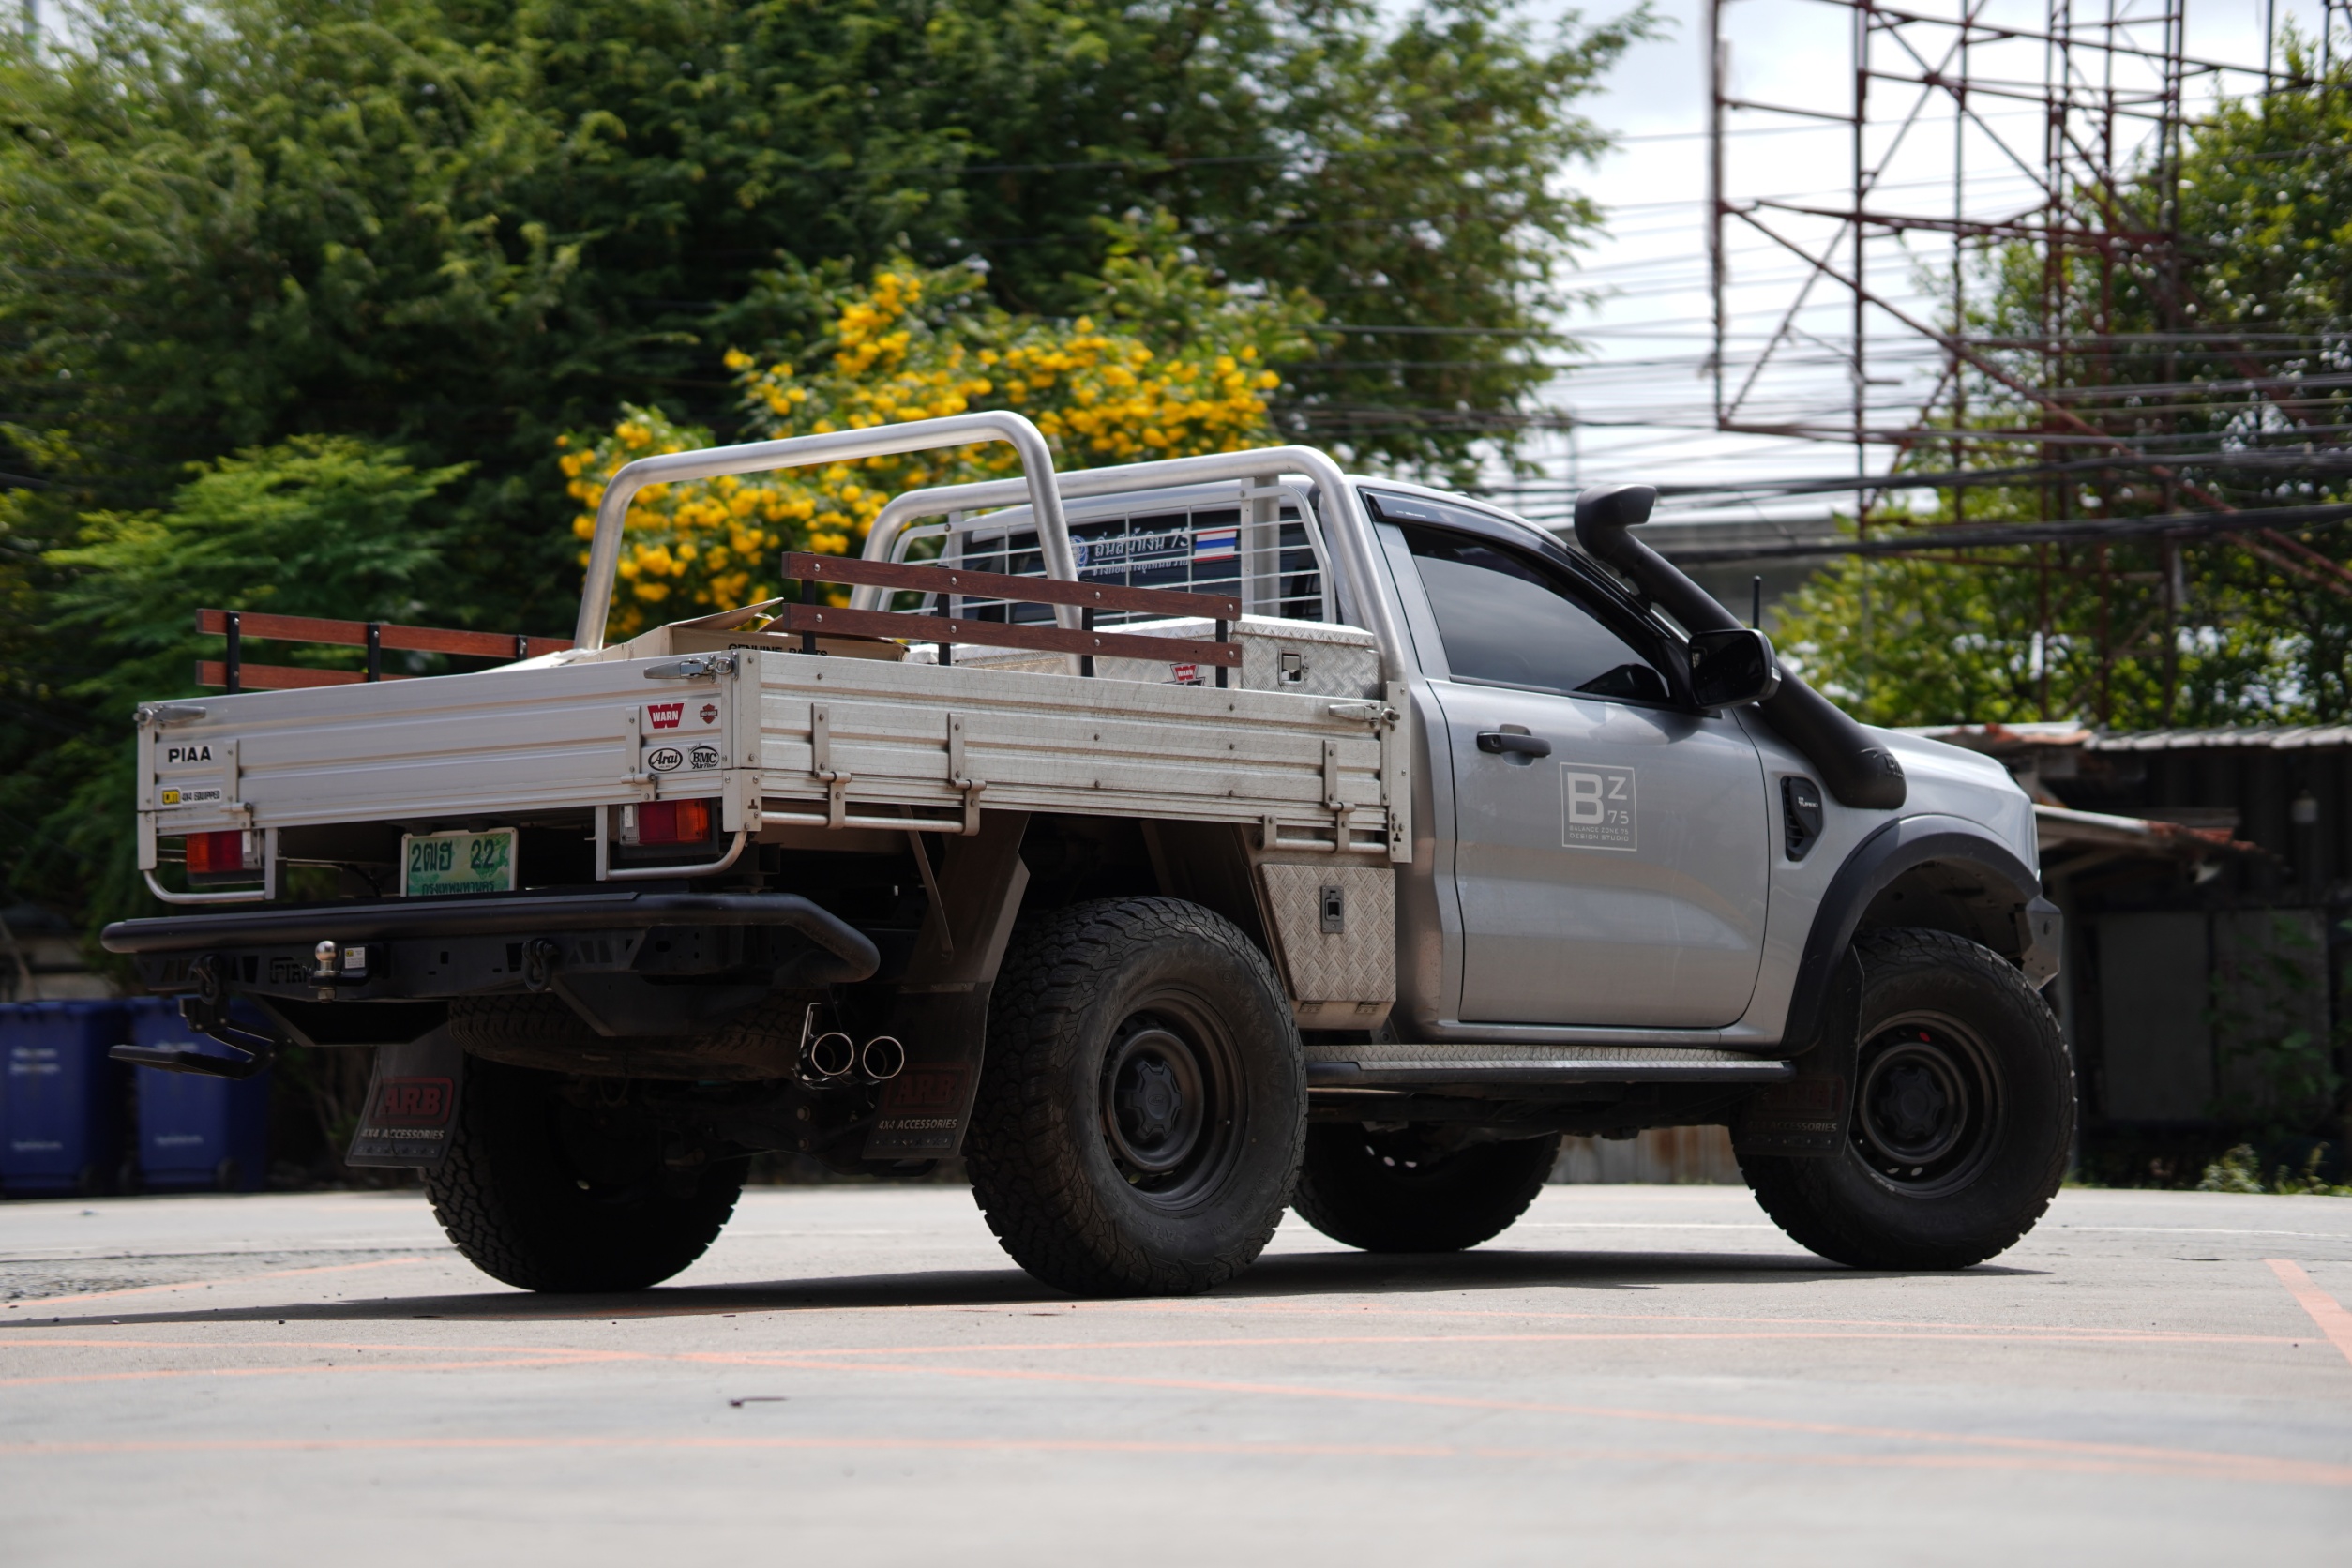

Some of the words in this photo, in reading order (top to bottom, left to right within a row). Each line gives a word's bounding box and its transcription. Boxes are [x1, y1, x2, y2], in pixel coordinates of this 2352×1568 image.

[653, 710, 679, 722] WARN
[168, 746, 212, 763] PIAA
[652, 750, 679, 765] Arai
[693, 752, 716, 763] BMC
[1607, 809, 1629, 824] 75
[1601, 834, 1629, 842] STUDIO
[471, 839, 494, 868] 22
[894, 1073, 957, 1104] ARB
[377, 1087, 442, 1115] ARB
[897, 1118, 957, 1130] ACCESSORIES
[1770, 1121, 1838, 1133] ACCESSORIES
[382, 1129, 444, 1139] ACCESSORIES
